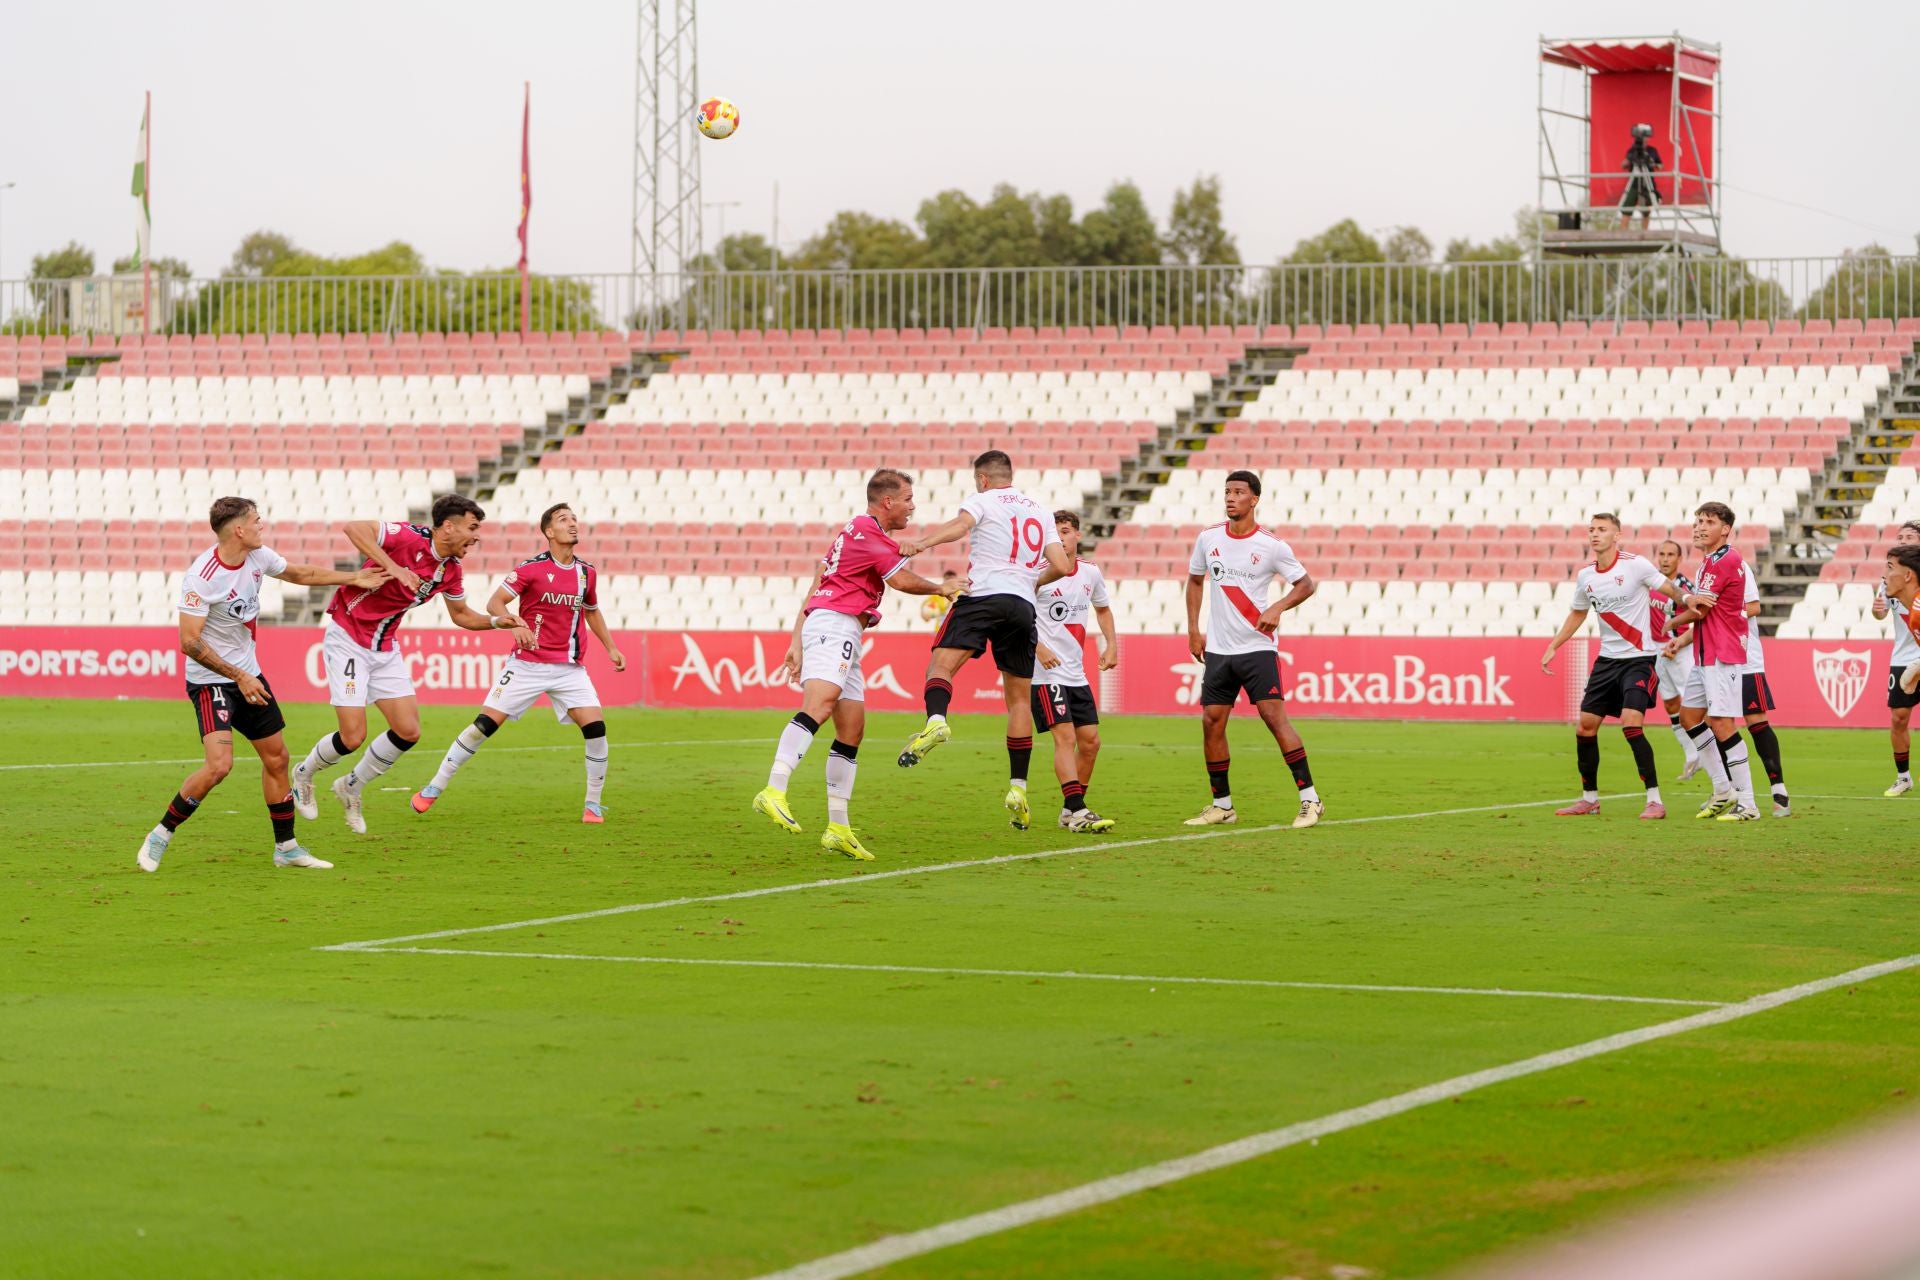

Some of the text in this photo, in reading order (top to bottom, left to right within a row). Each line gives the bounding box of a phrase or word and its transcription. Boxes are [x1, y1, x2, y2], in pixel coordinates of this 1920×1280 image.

[1010, 515, 1044, 568] 19
[841, 641, 853, 661] 9
[343, 658, 356, 680] 4
[499, 670, 515, 686] 5
[212, 686, 226, 707] 4
[1049, 684, 1063, 703] 2
